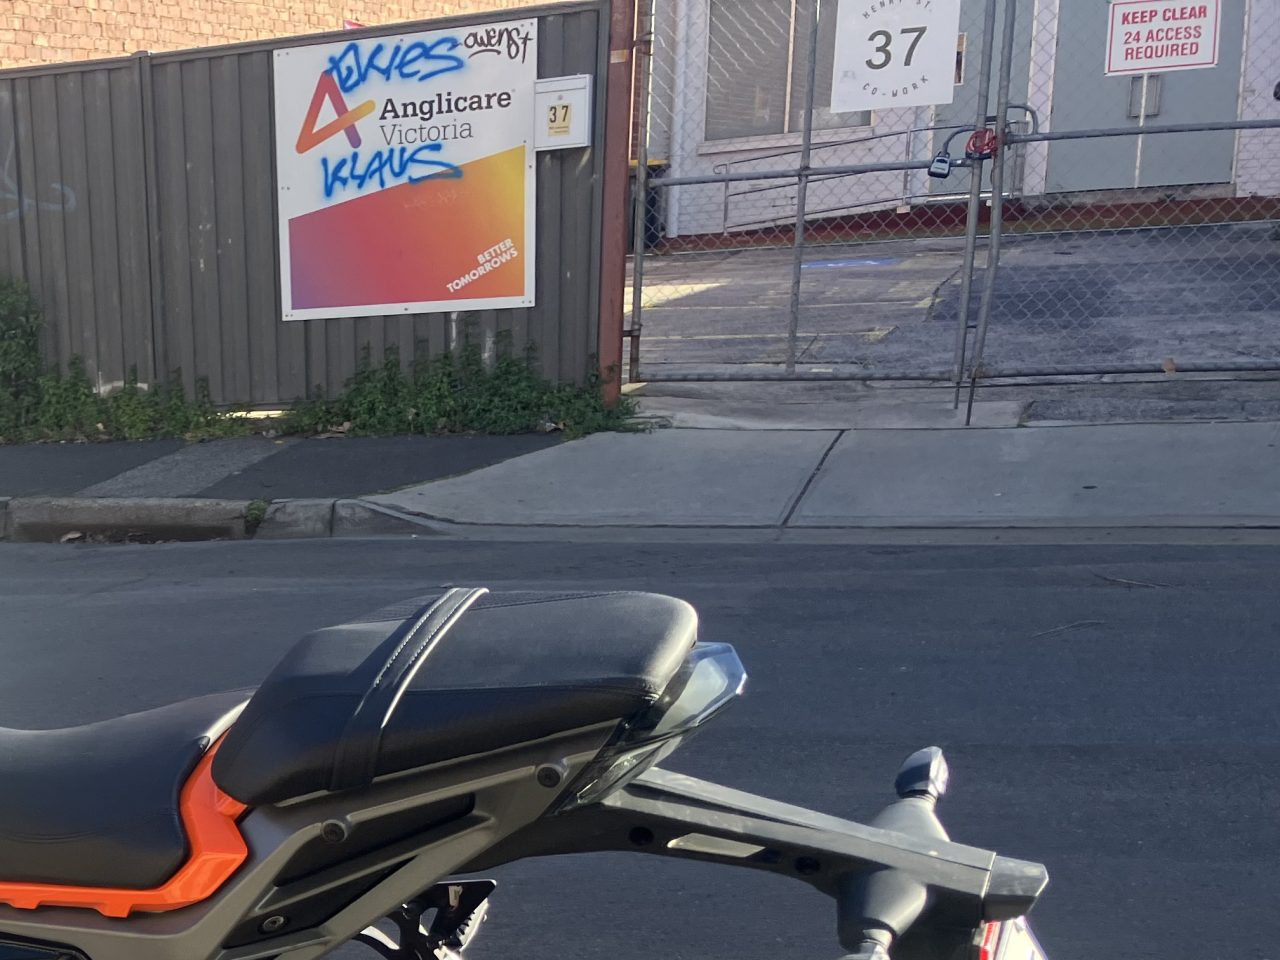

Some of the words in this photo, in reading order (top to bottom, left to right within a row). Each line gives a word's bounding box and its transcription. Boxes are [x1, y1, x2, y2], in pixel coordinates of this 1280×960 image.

[1122, 9, 1158, 25] KEEP
[1162, 5, 1207, 21] CLEAR
[1124, 31, 1141, 44] 24
[1145, 25, 1202, 42] ACCESS
[865, 26, 928, 70] 37
[1125, 42, 1199, 60] REQUIRED
[379, 90, 512, 121] Anglicare
[549, 105, 569, 123] 37
[380, 119, 474, 146] Victoria
[477, 238, 514, 264] BETTER
[446, 248, 519, 293] TOMORROWS
